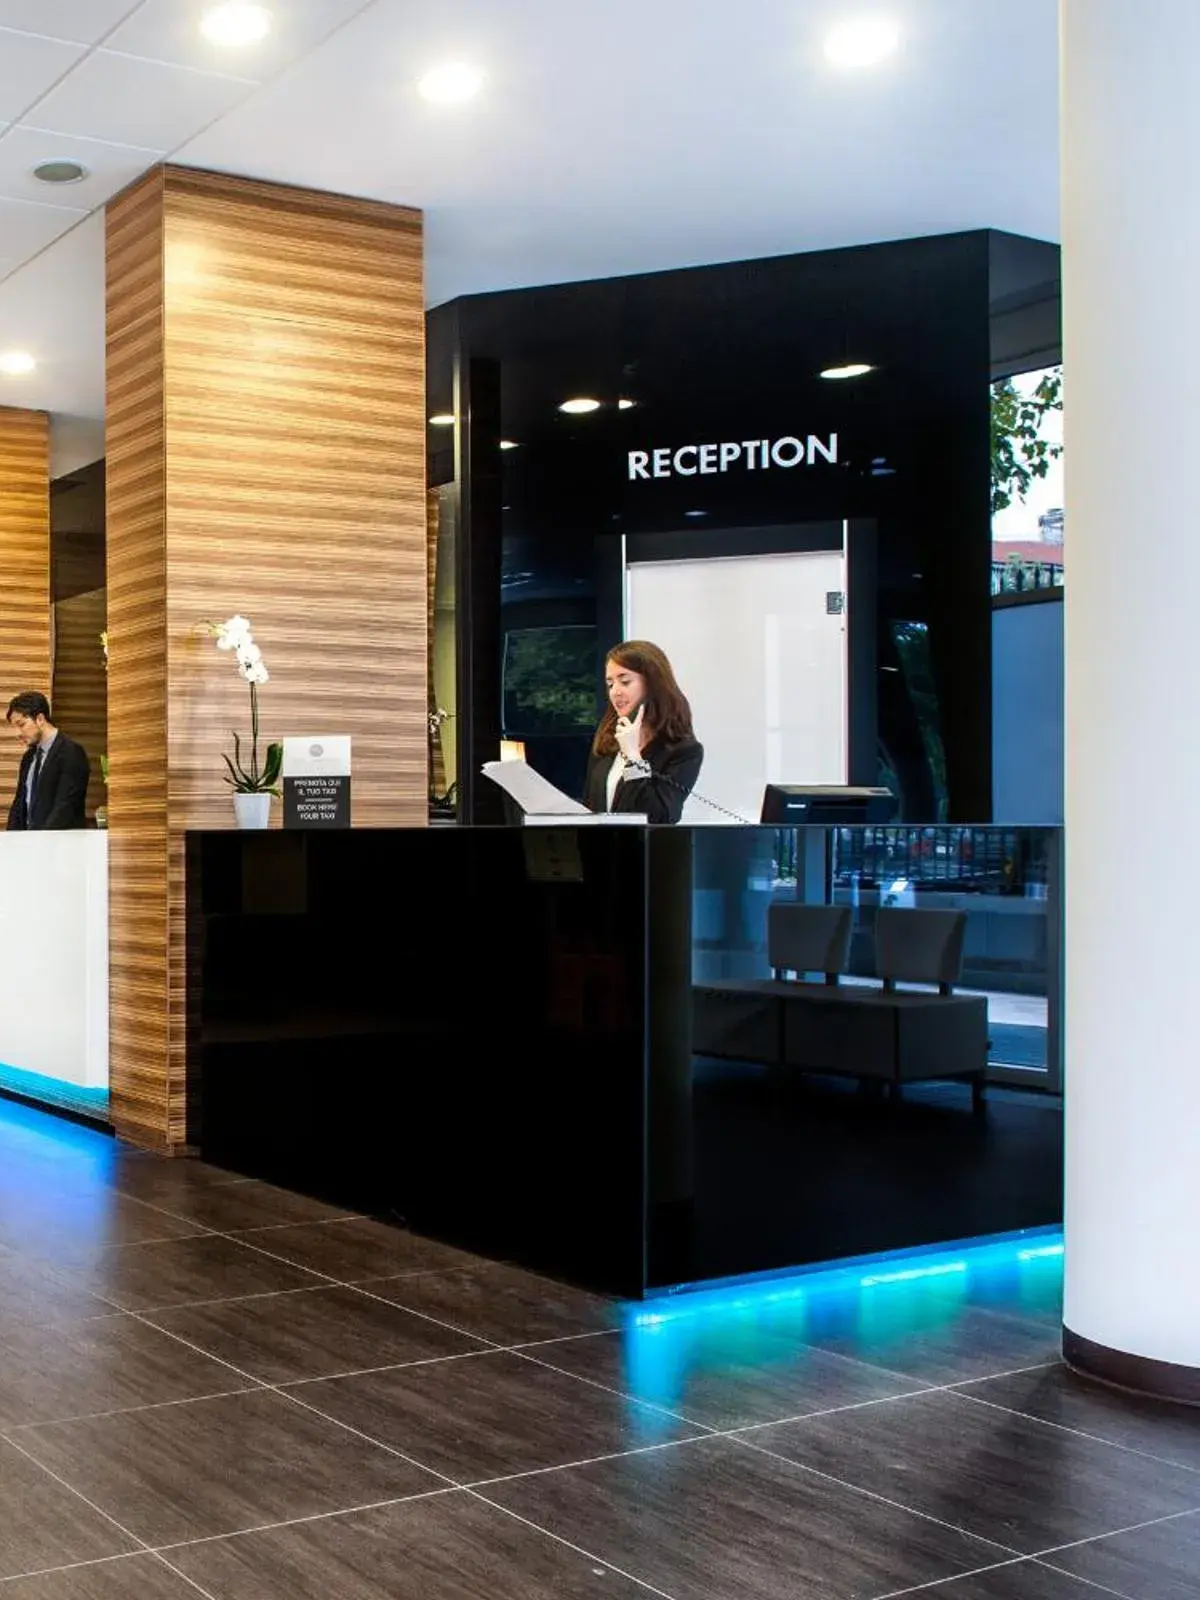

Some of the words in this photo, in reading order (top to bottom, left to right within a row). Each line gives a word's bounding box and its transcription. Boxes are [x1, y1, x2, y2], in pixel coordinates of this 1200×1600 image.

[628, 433, 838, 481] RECEPTION
[306, 788, 320, 796] TUO
[297, 804, 317, 812] BOOK
[300, 812, 319, 820] YOUR
[320, 812, 335, 820] TAXI
